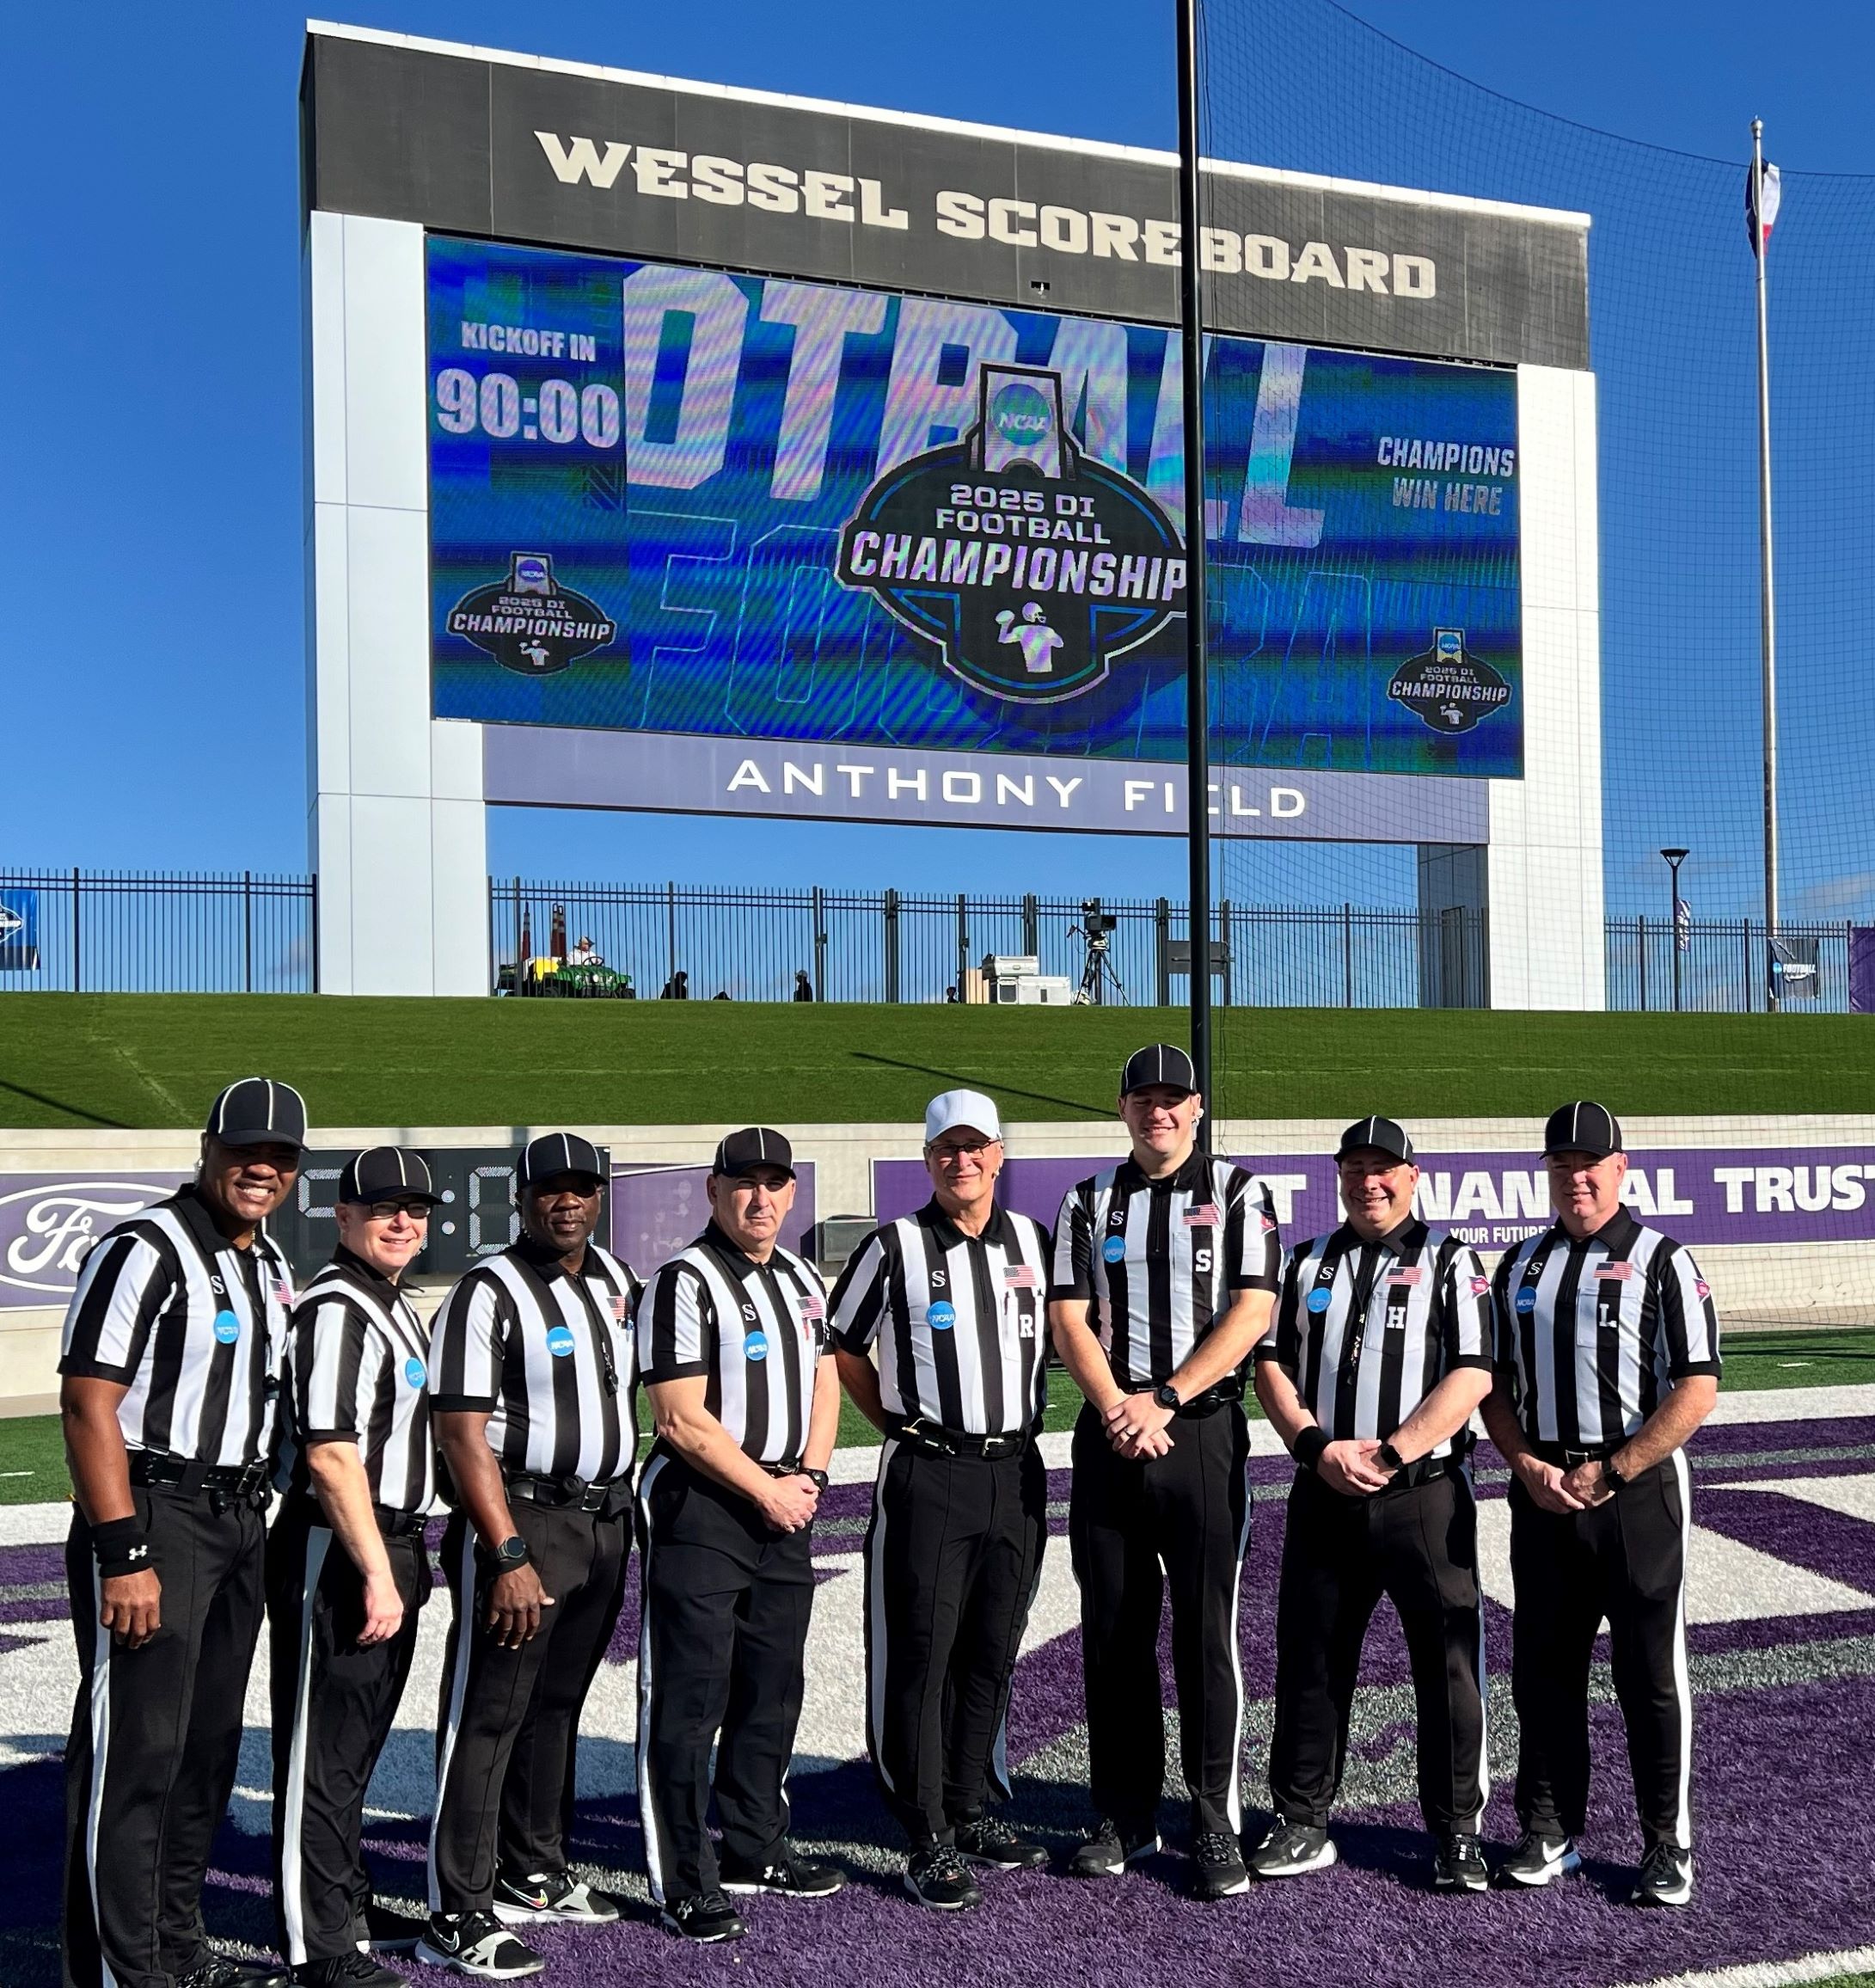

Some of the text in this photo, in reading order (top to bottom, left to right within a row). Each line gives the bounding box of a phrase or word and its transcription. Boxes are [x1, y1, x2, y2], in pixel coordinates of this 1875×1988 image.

[534, 131, 1437, 299] WESSEL SCOREBOARD
[461, 320, 596, 361] KICKOFF IN
[437, 368, 620, 448] 90:00
[998, 412, 1051, 432] NCAA
[1377, 436, 1516, 477] CHAMPIONS
[950, 484, 1095, 518] 2025 DI
[1393, 477, 1502, 515] WIN HERE
[935, 507, 1111, 544] FOOTBALL
[849, 531, 1187, 601] CHAMPIONSHIP
[491, 604, 573, 619] FOOTBALL
[453, 613, 610, 641] CHAMPIONSHIP
[1392, 680, 1508, 703] CHAMPIONSHIP
[1420, 673, 1480, 684] FOOTBALL
[726, 759, 1083, 808] ANTHONY
[1713, 1164, 1875, 1213] TRUS
[1450, 1227, 1489, 1243] YOUR
[1195, 1249, 1211, 1273] S
[1517, 1298, 1535, 1307] NCAA
[1599, 1304, 1617, 1328] L
[1020, 1314, 1033, 1338] R
[1387, 1306, 1406, 1329] H
